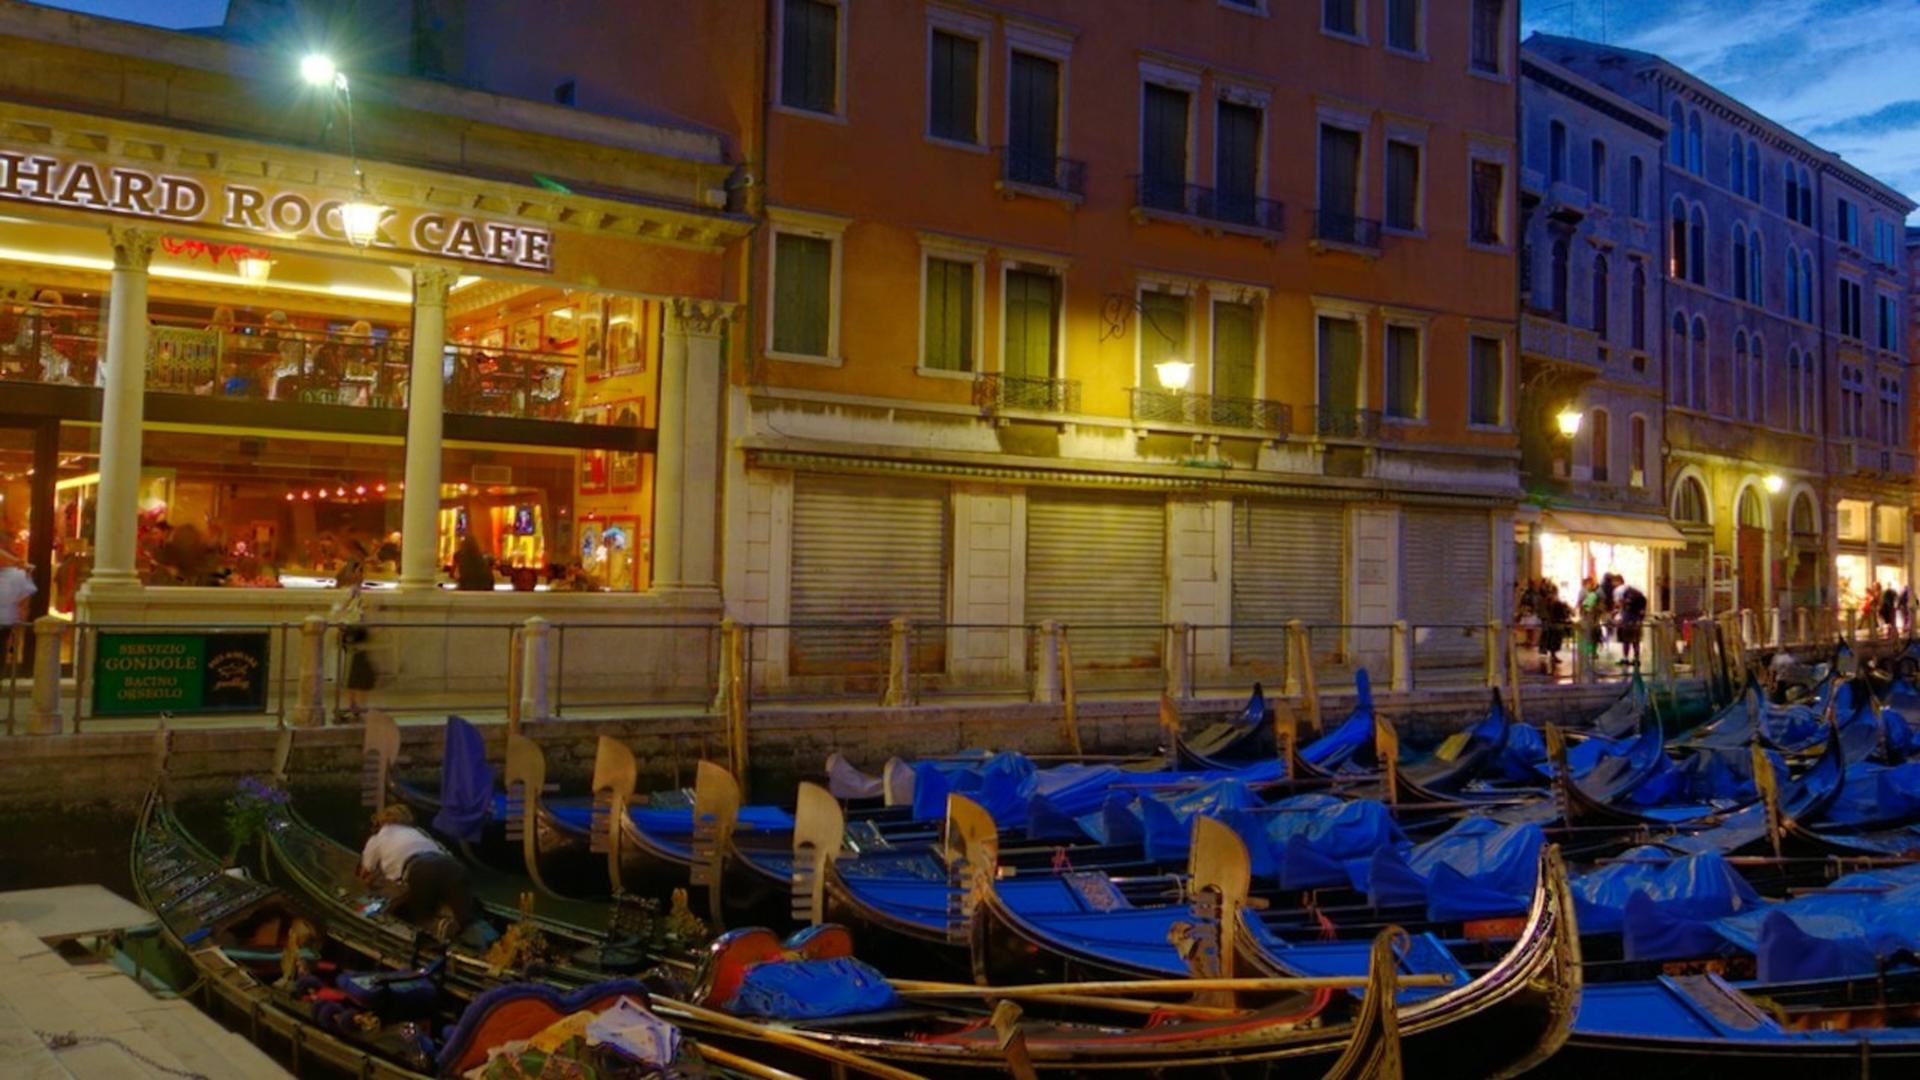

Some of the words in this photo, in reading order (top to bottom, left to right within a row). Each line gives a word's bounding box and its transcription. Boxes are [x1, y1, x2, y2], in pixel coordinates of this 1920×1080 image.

[0, 151, 207, 222] HARD
[411, 213, 554, 270] CAFE
[119, 643, 186, 655] SERVIZIO
[105, 656, 198, 671] GONDOLE
[123, 675, 178, 688] BACINO
[117, 687, 183, 700] ORSEOLO
